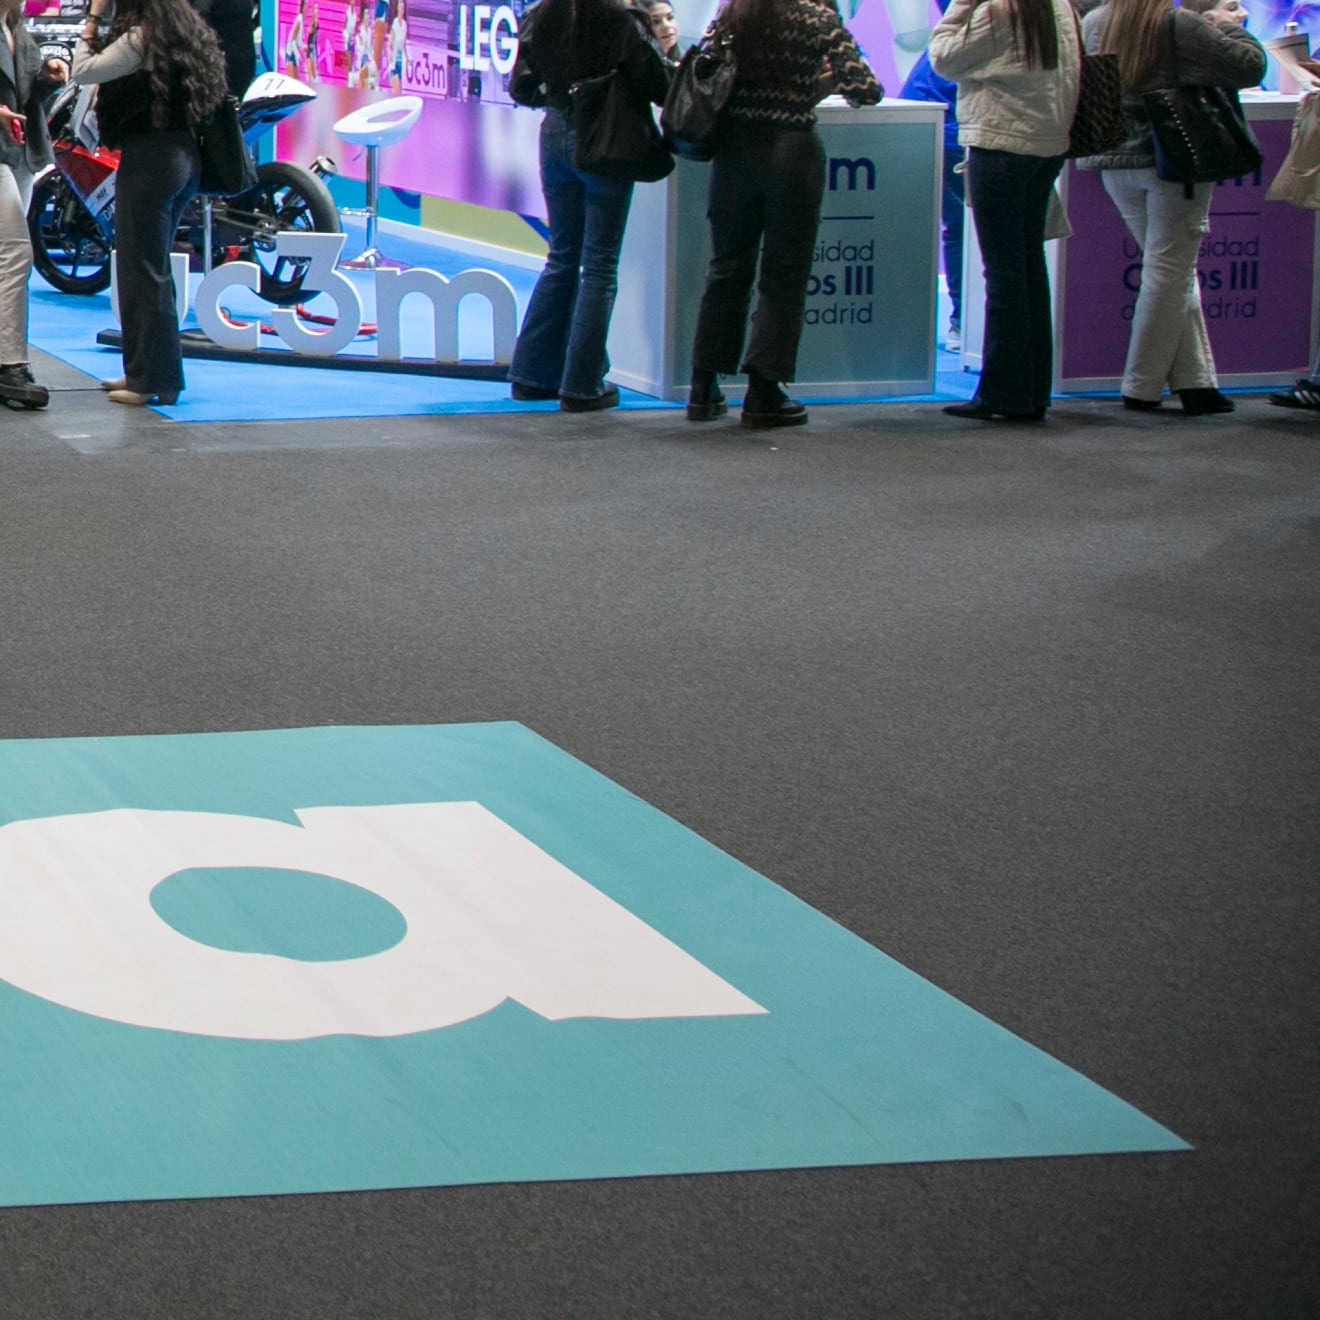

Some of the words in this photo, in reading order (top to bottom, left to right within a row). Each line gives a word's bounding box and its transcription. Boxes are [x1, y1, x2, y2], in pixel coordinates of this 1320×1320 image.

[844, 265, 874, 296] III
[1229, 259, 1259, 291] III
[110, 231, 518, 364] c3m
[804, 302, 873, 326] adrid
